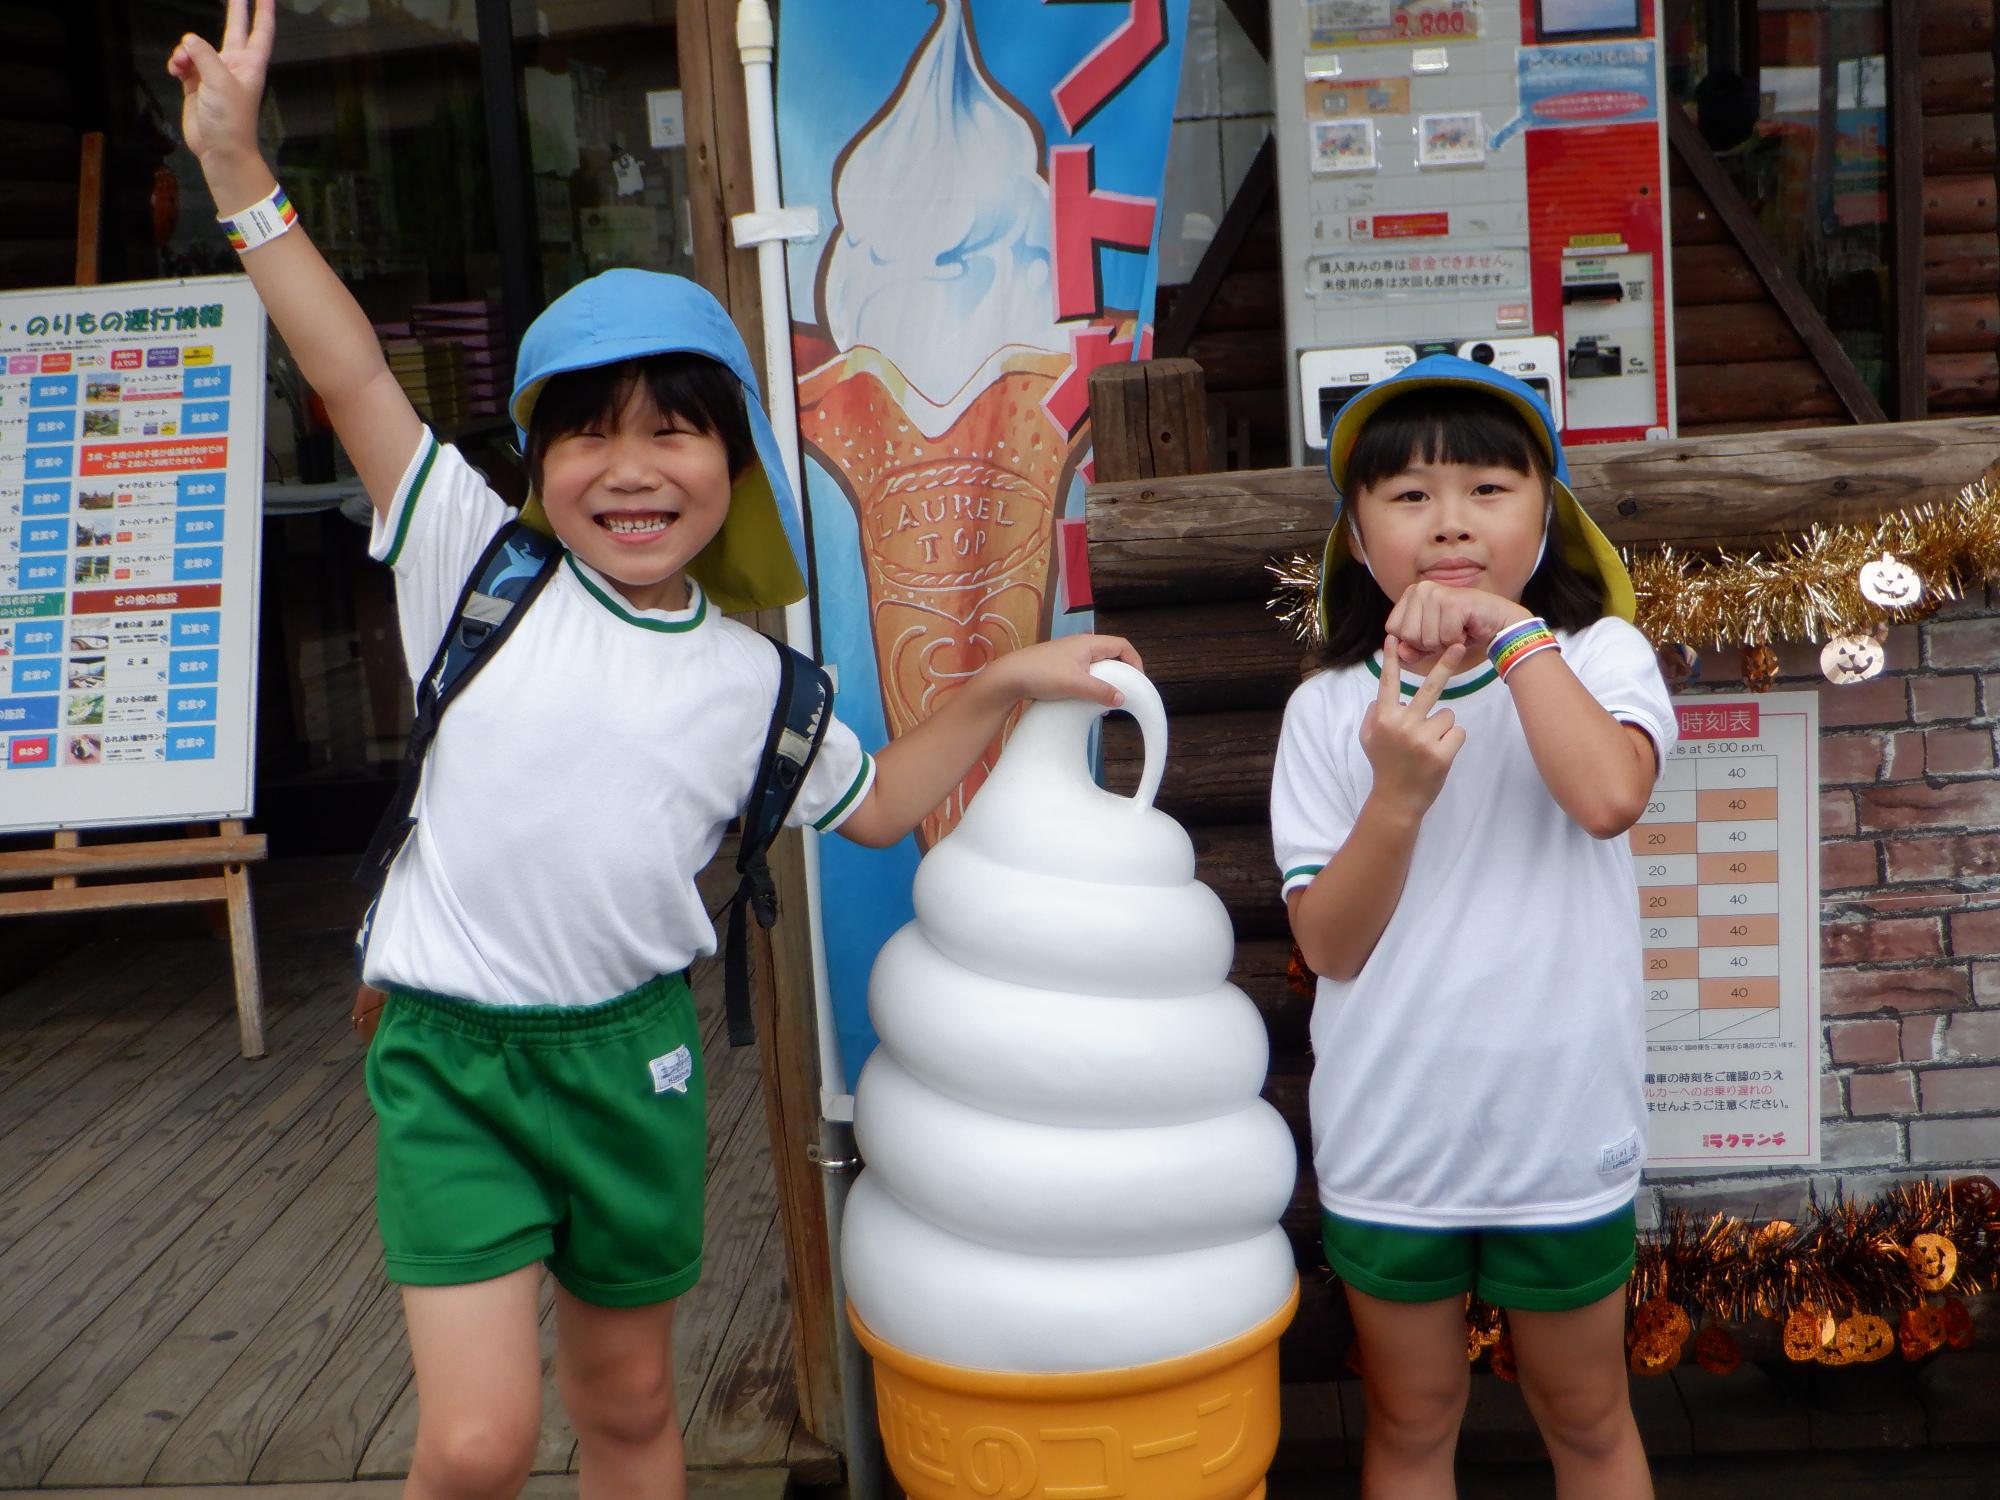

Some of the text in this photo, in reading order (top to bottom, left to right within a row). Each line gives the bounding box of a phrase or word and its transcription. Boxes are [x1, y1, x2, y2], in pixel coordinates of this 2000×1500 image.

[1319, 256, 1513, 274] 購入済みの券は返金できません。
[1323, 274, 1510, 290] 未使用の券は次回も使用できます。
[876, 494, 1015, 538] LAUREL
[916, 526, 986, 563] TOP
[1681, 710, 1752, 733] 時刻表
[1676, 742, 1766, 754] is at 5:00 p.m.
[1727, 767, 1746, 778] 40
[1647, 800, 1747, 813] 20 40
[1648, 831, 1747, 844] 20 40
[1648, 863, 1747, 876] 20 40
[1649, 894, 1748, 907] 20 40
[1649, 926, 1748, 938] 20 40
[1650, 957, 1748, 970] 20 40
[1650, 988, 1749, 1001] 20 40
[1645, 1070, 1784, 1084] 電車の時刻をご確認のうえ
[1647, 1098, 1790, 1112] ませんようご注意ください。
